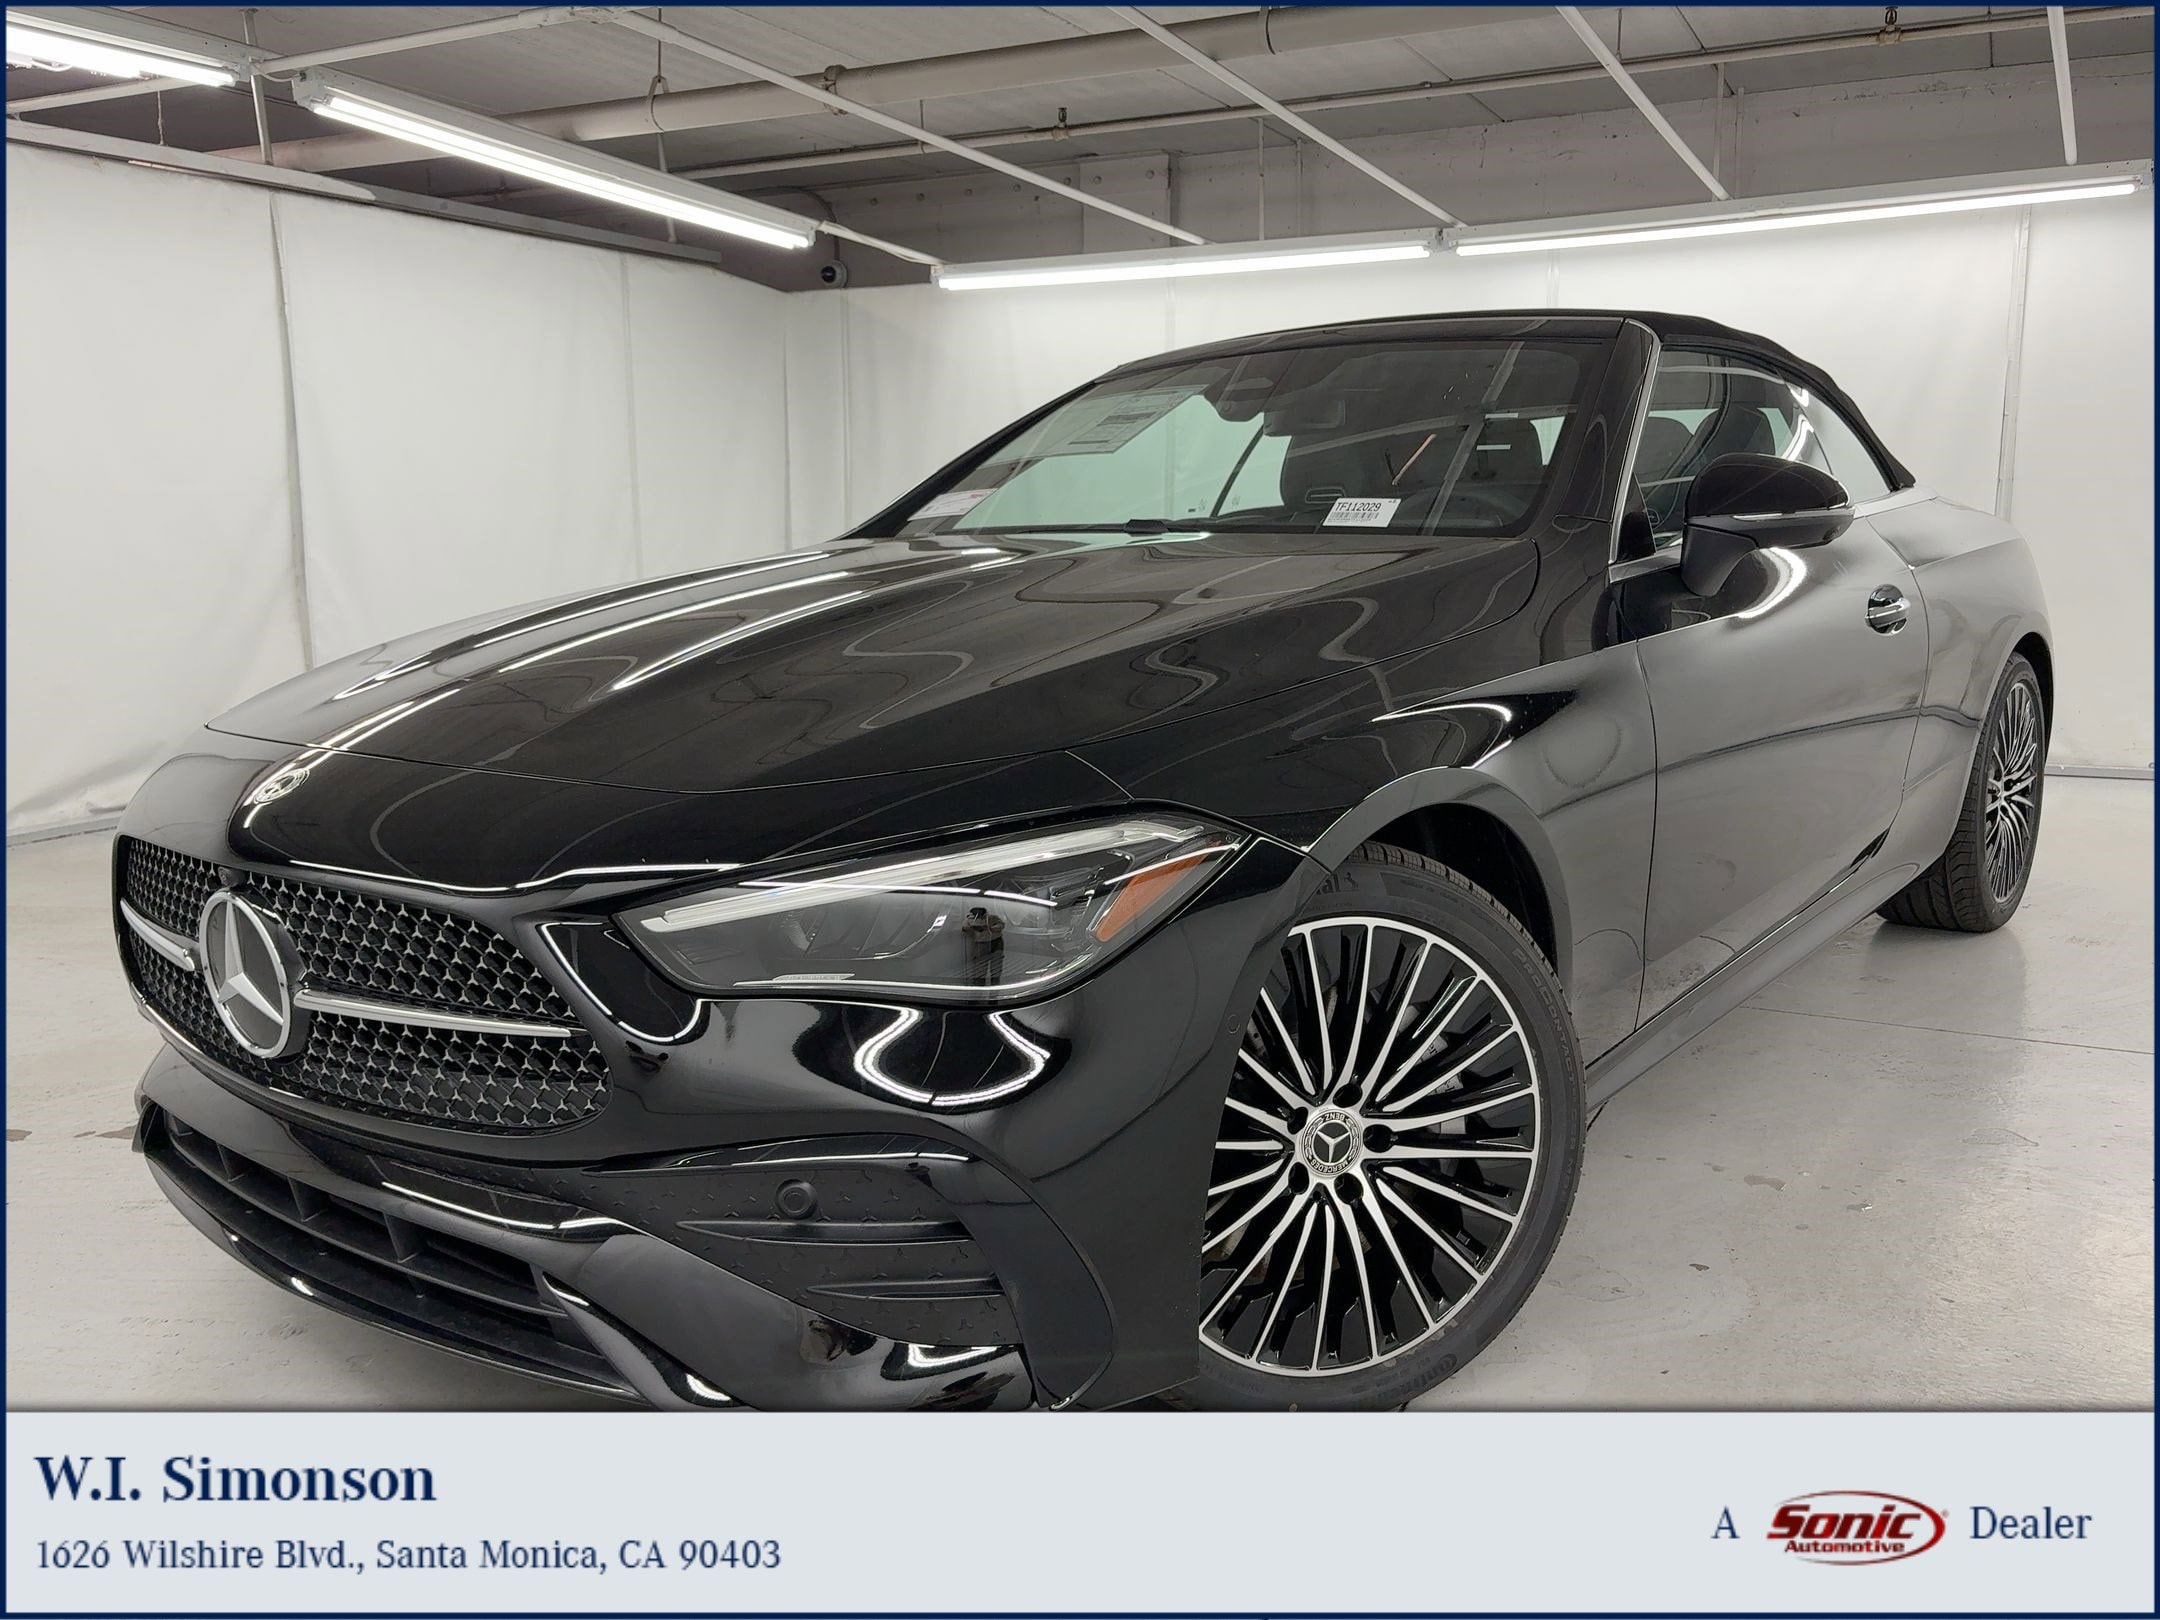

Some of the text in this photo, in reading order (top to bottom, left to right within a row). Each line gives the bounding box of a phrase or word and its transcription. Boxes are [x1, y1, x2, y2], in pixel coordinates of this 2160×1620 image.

[1335, 502, 1382, 512] TF112029
[1324, 1112, 1346, 1121] BENZ
[1310, 1159, 1349, 1174] MERCEDES
